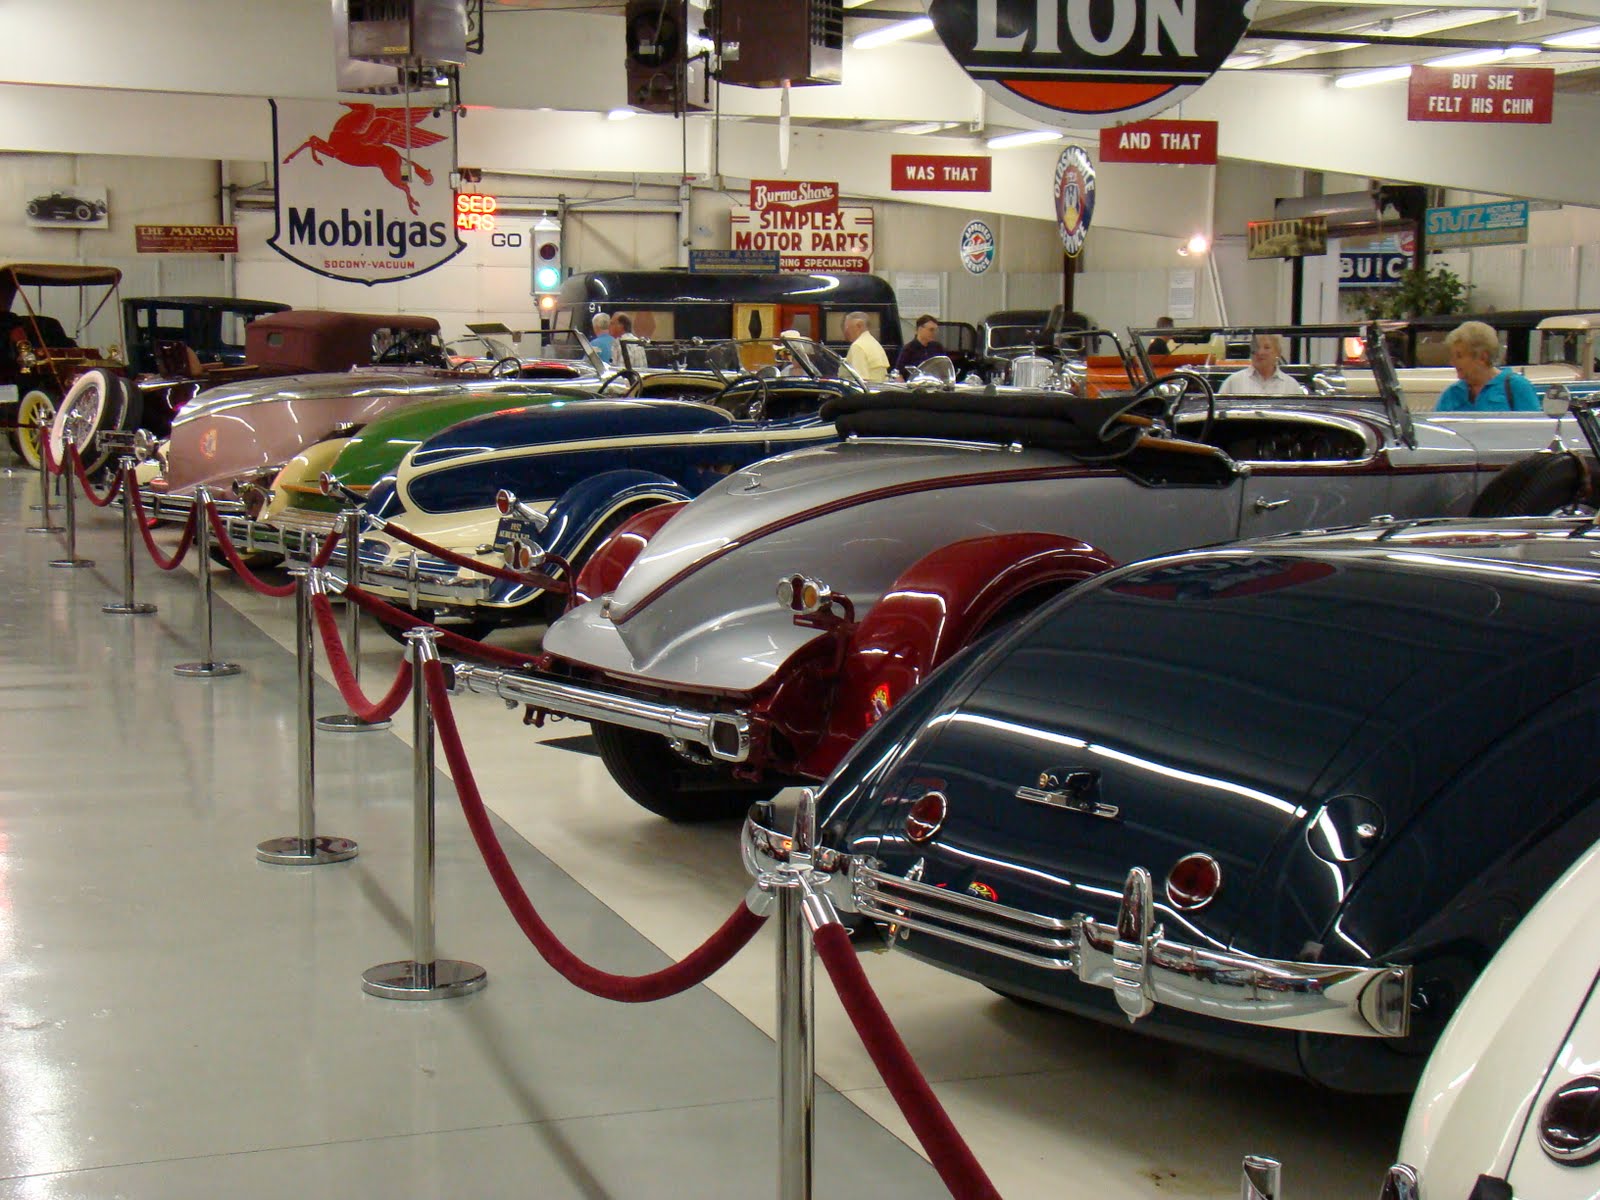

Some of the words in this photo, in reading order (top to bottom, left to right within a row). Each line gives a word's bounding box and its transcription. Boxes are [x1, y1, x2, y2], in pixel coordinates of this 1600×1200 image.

[972, 0, 1198, 56] LION
[1452, 73, 1478, 89] BUT
[1487, 75, 1514, 90] SHE
[1428, 96, 1462, 112] FELT
[1471, 98, 1493, 113] HIS
[1503, 99, 1533, 114] CHIN
[1119, 132, 1151, 149] AND
[1160, 133, 1201, 150] THAT
[906, 165, 935, 180] WAS
[943, 166, 978, 181] THAT
[456, 194, 497, 213] SED
[754, 185, 798, 210] Burma
[799, 182, 834, 201] Shave
[456, 212, 496, 231] ARS
[760, 210, 845, 231] SIMPLEX
[1429, 207, 1485, 233] STUTZ
[139, 226, 166, 236] THE
[170, 227, 236, 237] MARMON
[288, 207, 447, 259] Mobilgas
[491, 233, 522, 248] GO
[736, 231, 802, 251] MOTOR
[812, 232, 868, 252] PARTS
[324, 260, 416, 270] SOCONY-VACUUM
[779, 258, 801, 268] RING
[804, 258, 864, 268] SPECIALISTS
